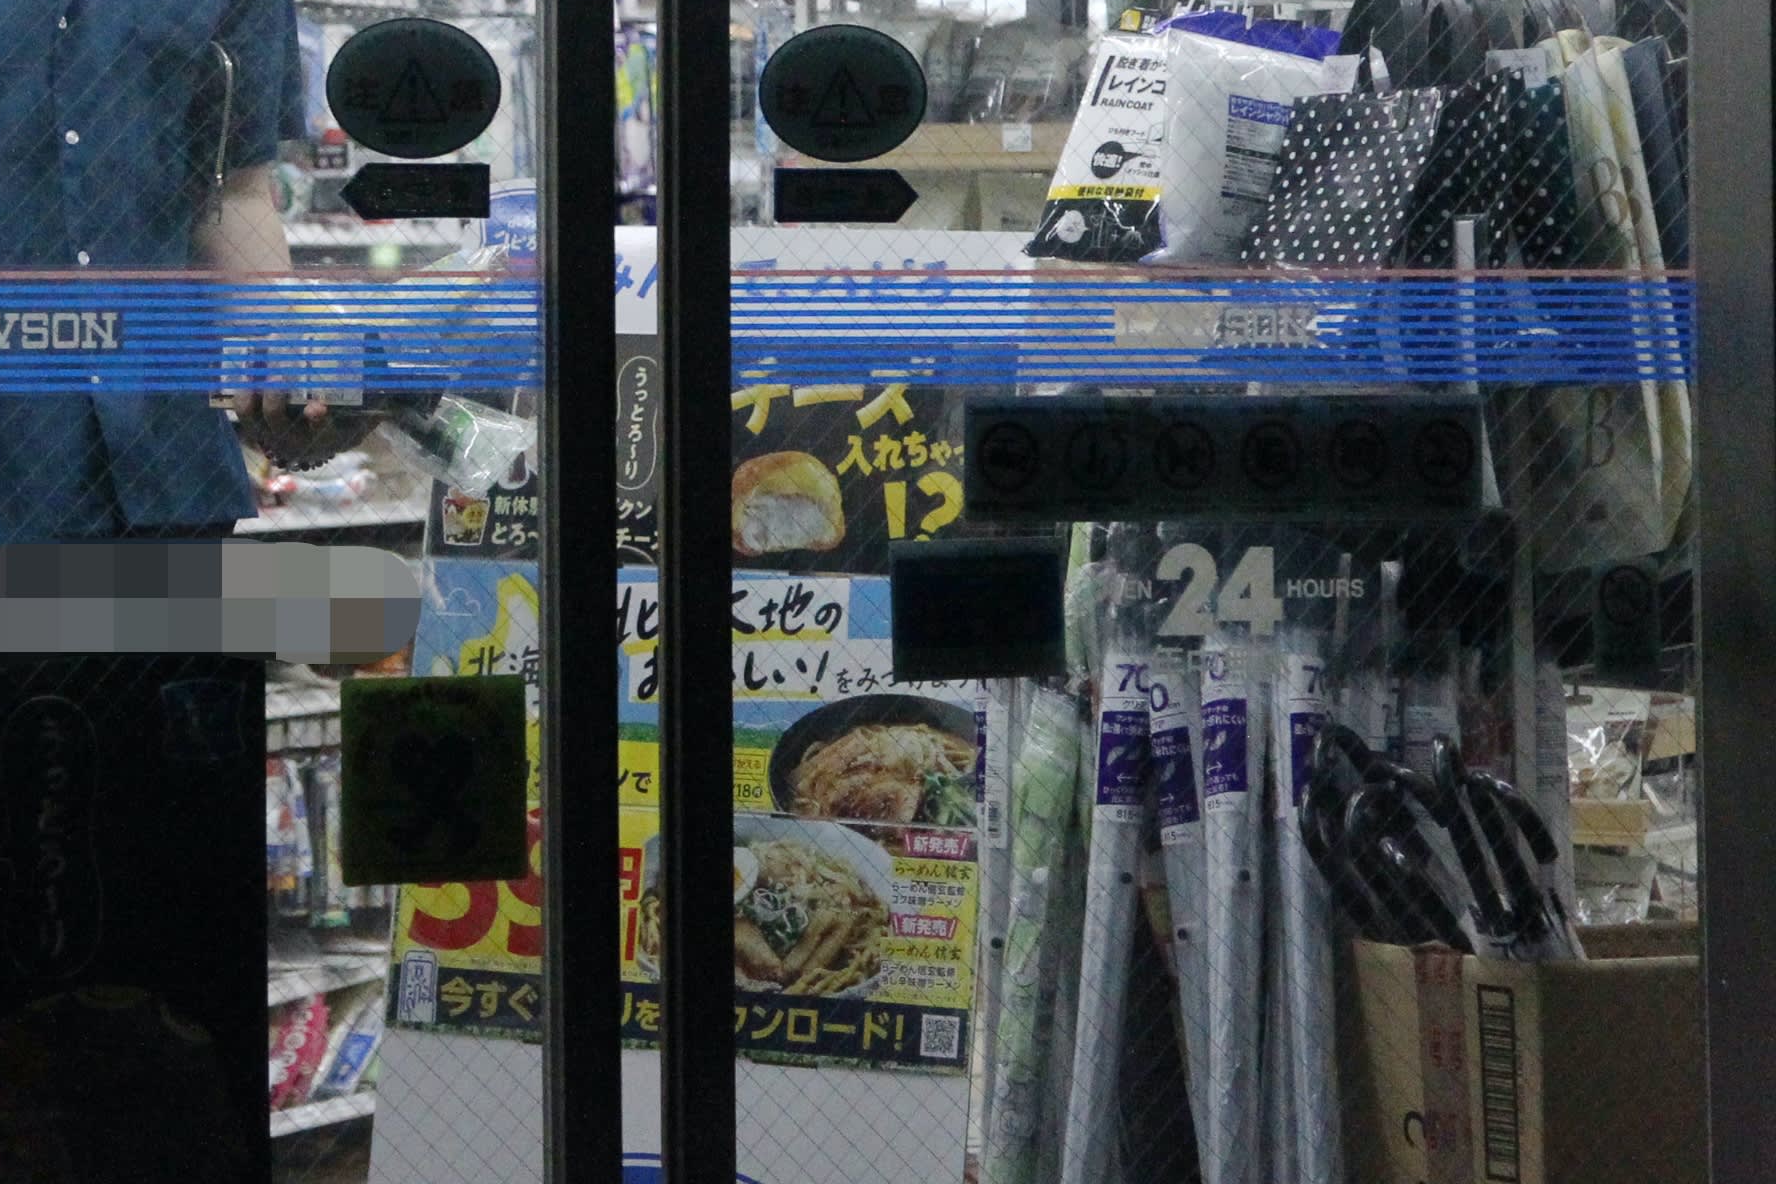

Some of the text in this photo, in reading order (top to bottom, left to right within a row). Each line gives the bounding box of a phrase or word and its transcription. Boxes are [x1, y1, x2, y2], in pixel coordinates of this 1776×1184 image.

[1155, 542, 1284, 636] 24
[1286, 578, 1365, 599] HOURS
[913, 836, 960, 855] 新発売
[902, 919, 948, 938] 新発売
